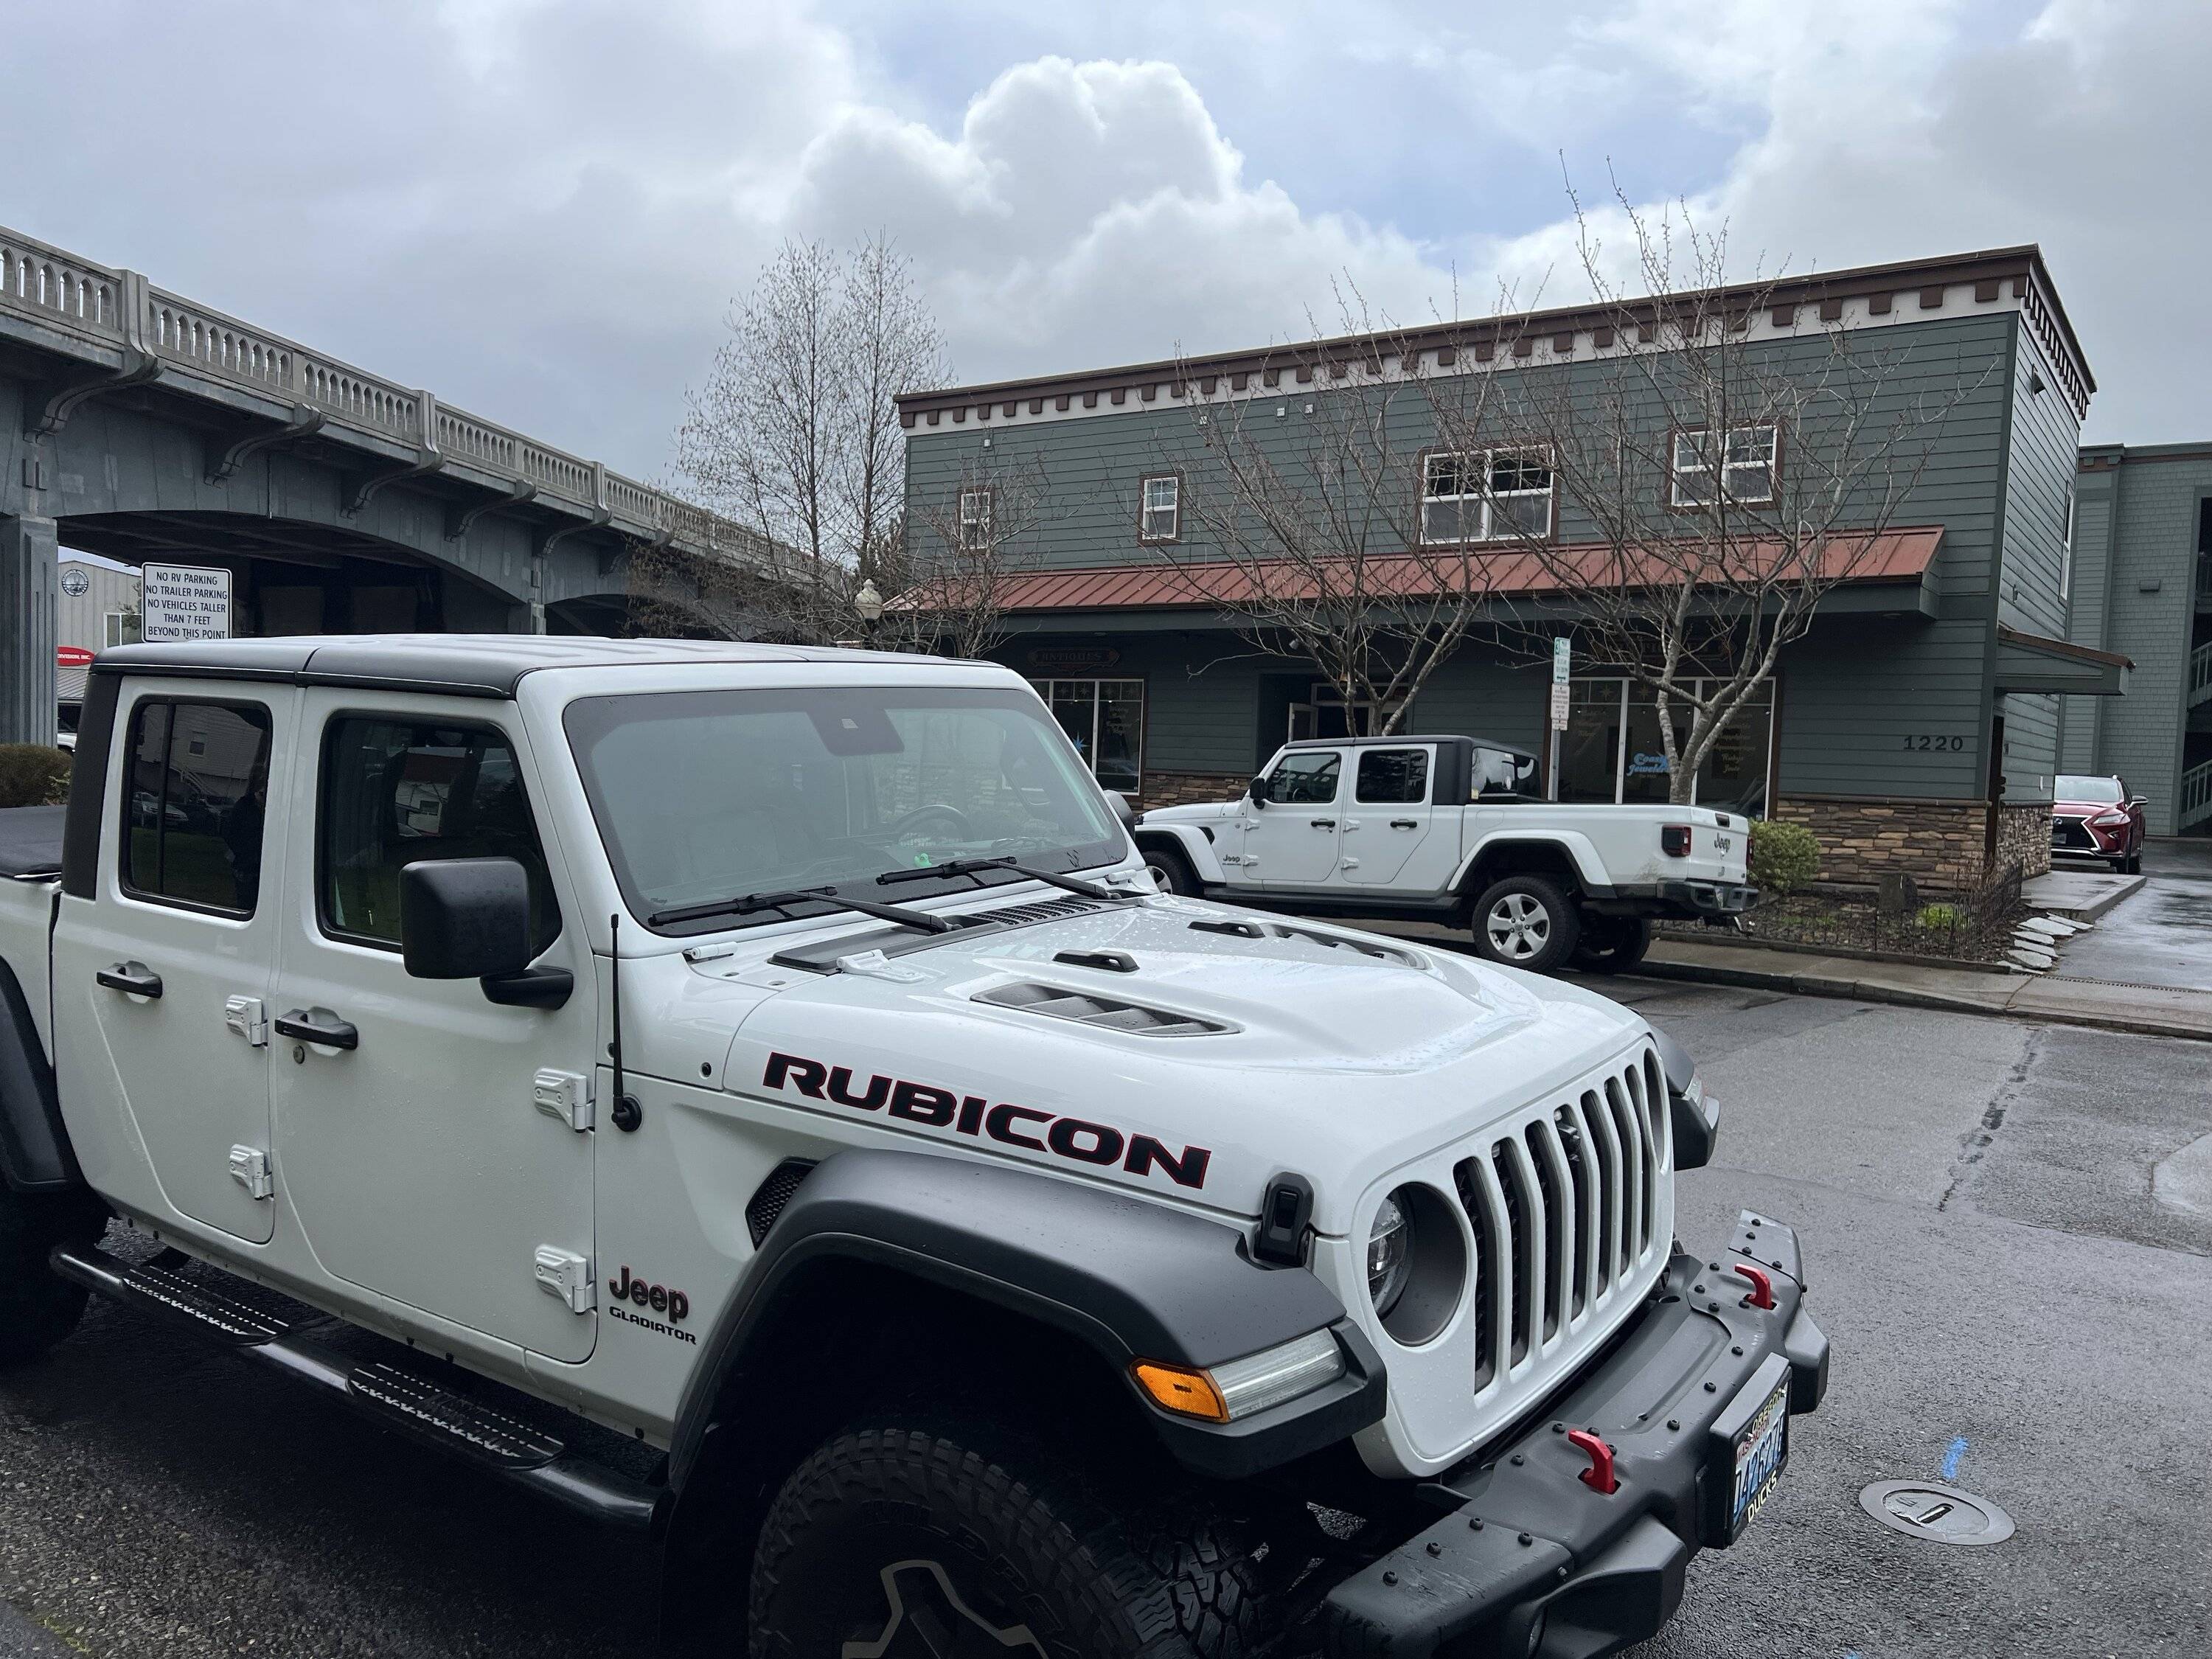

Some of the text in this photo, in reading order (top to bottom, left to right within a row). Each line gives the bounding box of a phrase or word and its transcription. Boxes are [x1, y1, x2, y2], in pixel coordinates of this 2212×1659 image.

[156, 571, 218, 585] NO RV PARKING
[146, 585, 227, 599] NO TRAILER PARKING
[147, 599, 226, 613] NO VEHICLES TALLER
[164, 613, 211, 625] THAN 7 FEET
[148, 626, 226, 639] BEYOND THIS POINT
[1904, 735, 1963, 751] 1220
[1223, 855, 1240, 863] Jeep
[762, 1051, 1212, 1190] RUBICON
[609, 1265, 689, 1324] Jeep
[609, 1306, 696, 1345] GLADIATOR
[1747, 1470, 1778, 1523] DUCKS
